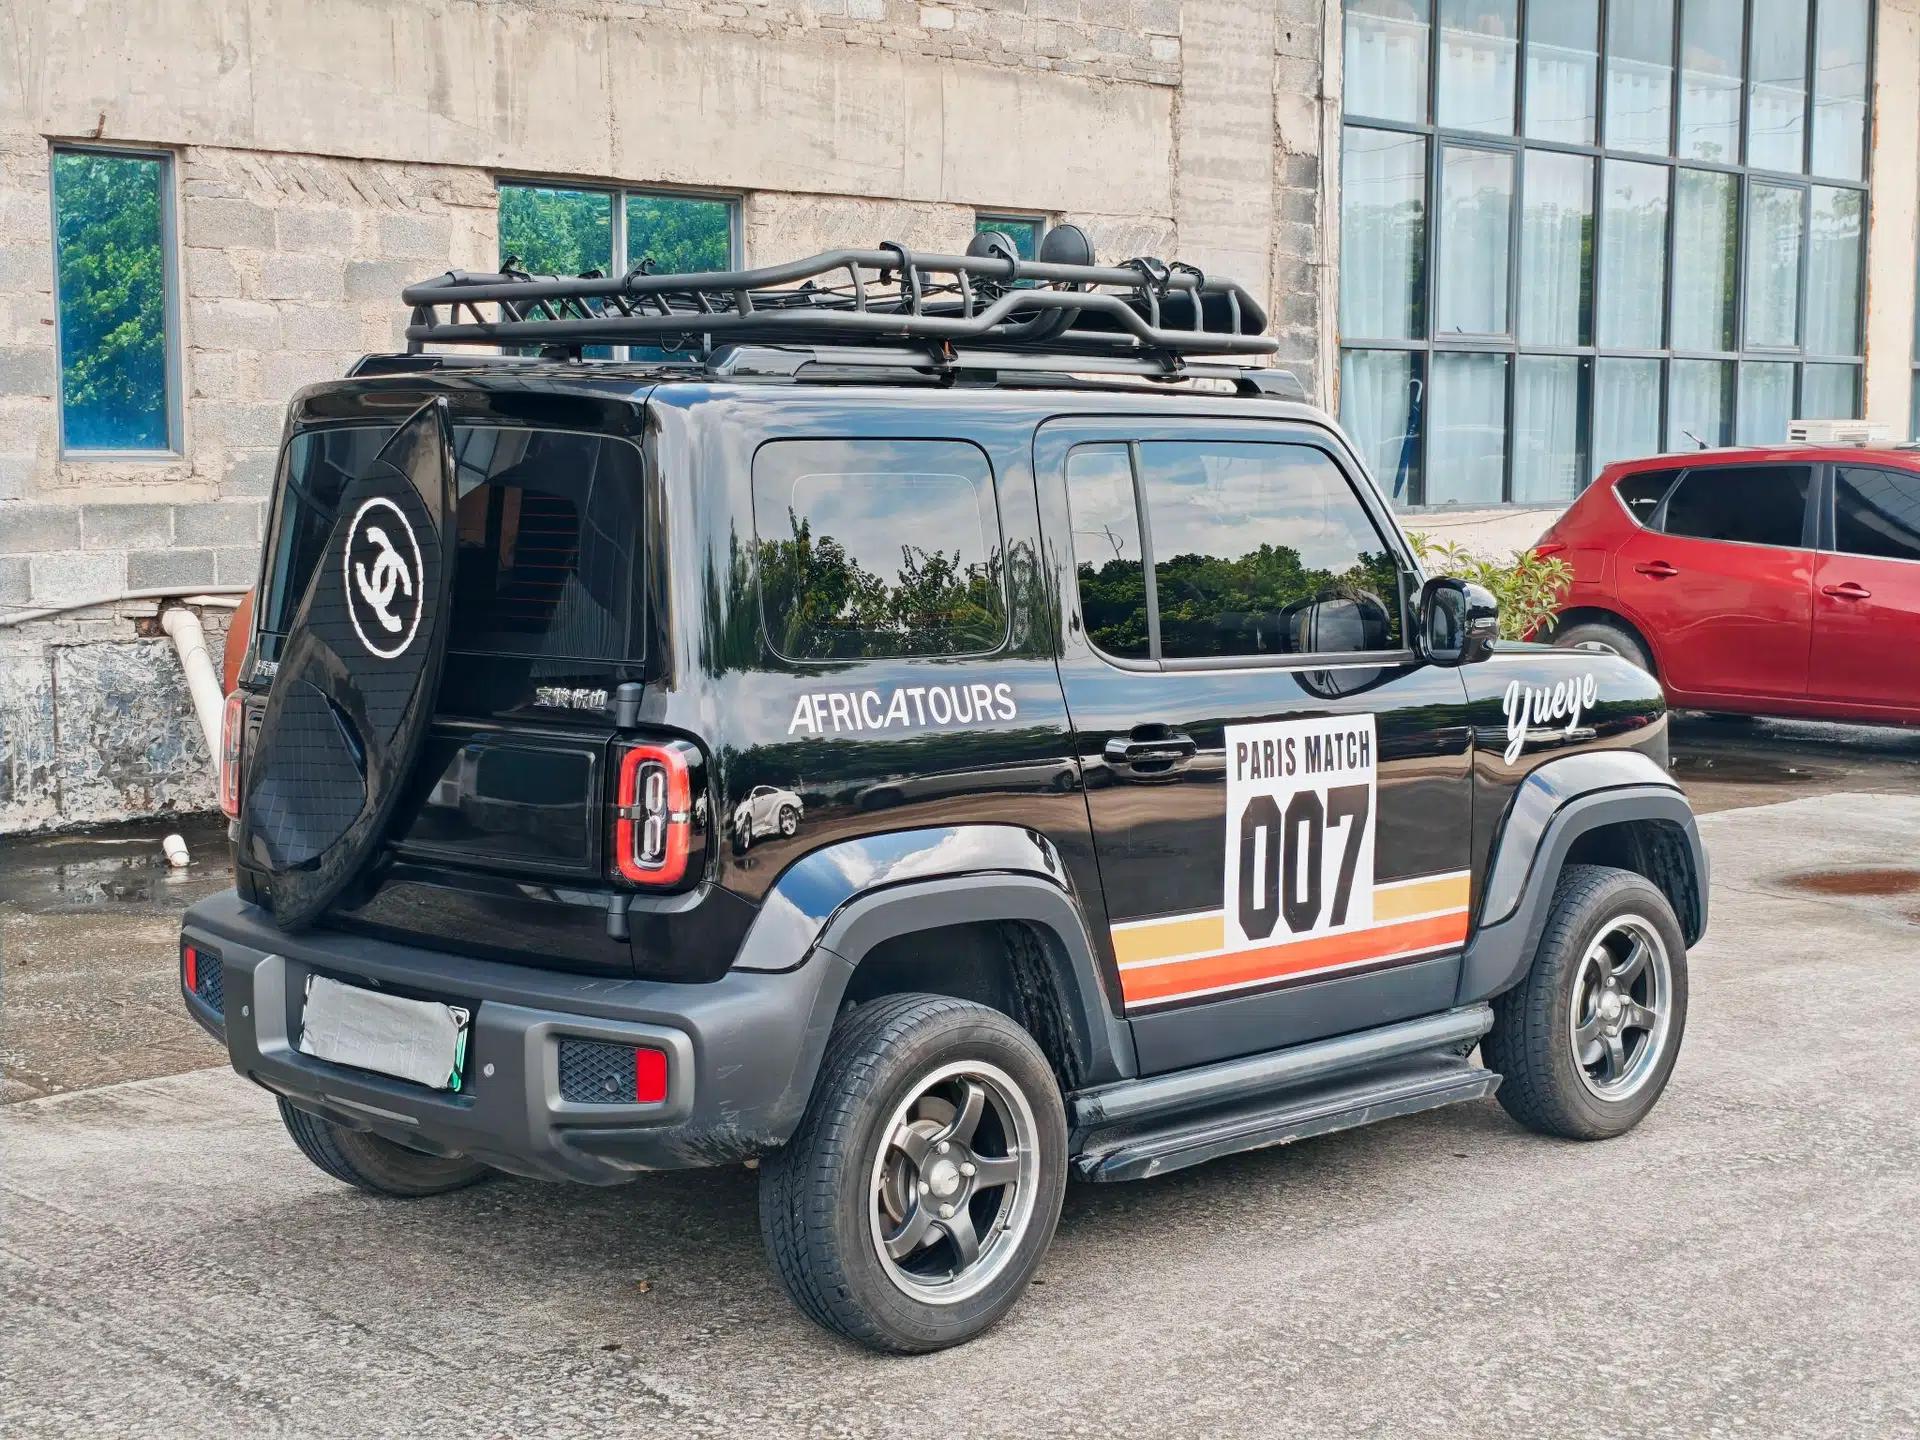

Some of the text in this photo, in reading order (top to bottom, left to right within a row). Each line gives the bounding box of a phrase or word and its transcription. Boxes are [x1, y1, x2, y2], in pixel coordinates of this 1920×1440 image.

[1236, 730, 1370, 781] PARIS MATCH
[1502, 672, 1598, 766] Yueye
[1238, 783, 1370, 941] 007
